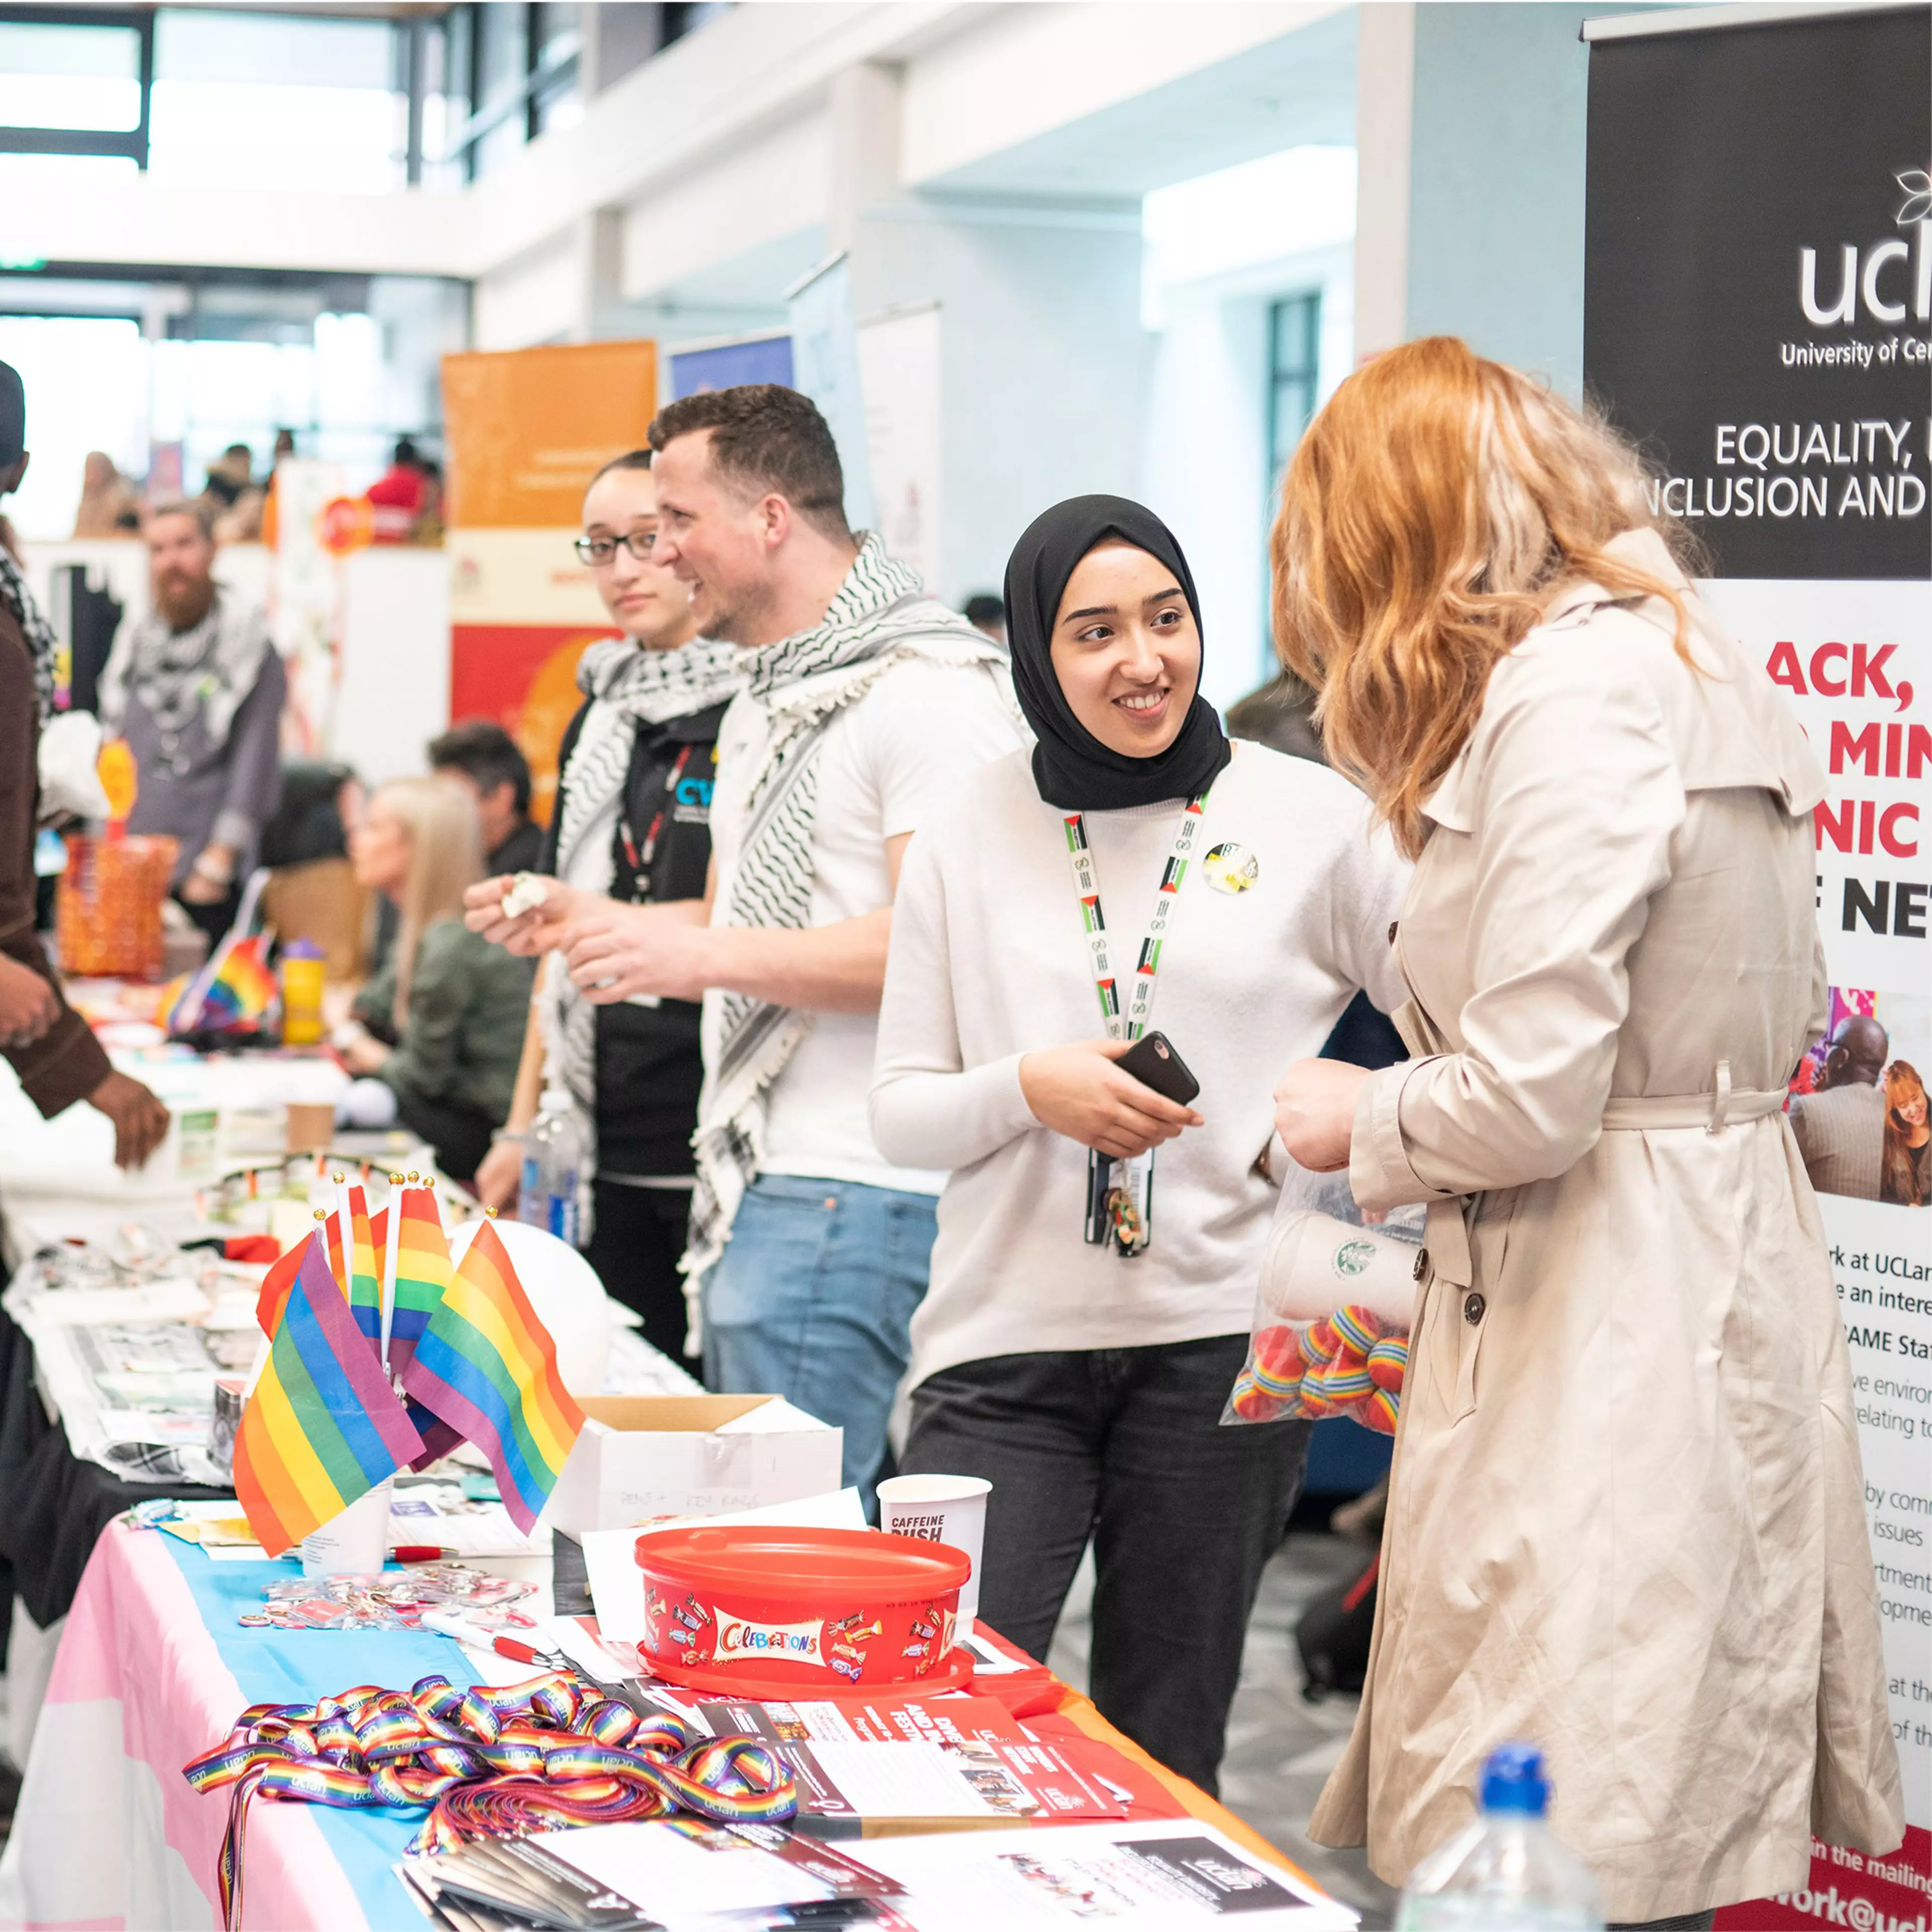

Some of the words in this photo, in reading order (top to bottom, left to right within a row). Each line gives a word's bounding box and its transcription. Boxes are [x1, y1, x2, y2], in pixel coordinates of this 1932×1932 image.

[1781, 340, 1874, 368] University
[1878, 337, 1899, 361] of
[1716, 422, 1912, 470] EQUALITY,
[1838, 474, 1925, 517] AND
[1766, 641, 1914, 712] ACK,
[1813, 798, 1919, 858] NIC
[1842, 877, 1932, 938] NE
[1850, 1253, 1869, 1271] at
[1850, 1286, 1873, 1304] an
[1844, 1324, 1892, 1352] AME
[1856, 1405, 1914, 1439] elating
[1865, 1480, 1885, 1509] by
[1890, 1491, 1932, 1515] com
[892, 1514, 945, 1527] CAFFEINE
[1874, 1515, 1923, 1547] issues
[489, 1698, 517, 1707] uclan
[1888, 1677, 1906, 1697] at
[1912, 1679, 1932, 1703] th
[387, 1740, 420, 1751] uclan
[505, 1751, 538, 1760] uclan
[224, 1750, 255, 1770] uclan
[602, 1756, 634, 1767] uclan
[706, 1753, 729, 1782] uclan
[291, 1777, 327, 1794] uclan
[377, 1780, 406, 1805] uclan
[704, 1800, 739, 1817] uclan
[765, 1800, 790, 1817] uclan
[1811, 1834, 1827, 1860] in
[1831, 1845, 1864, 1871] the
